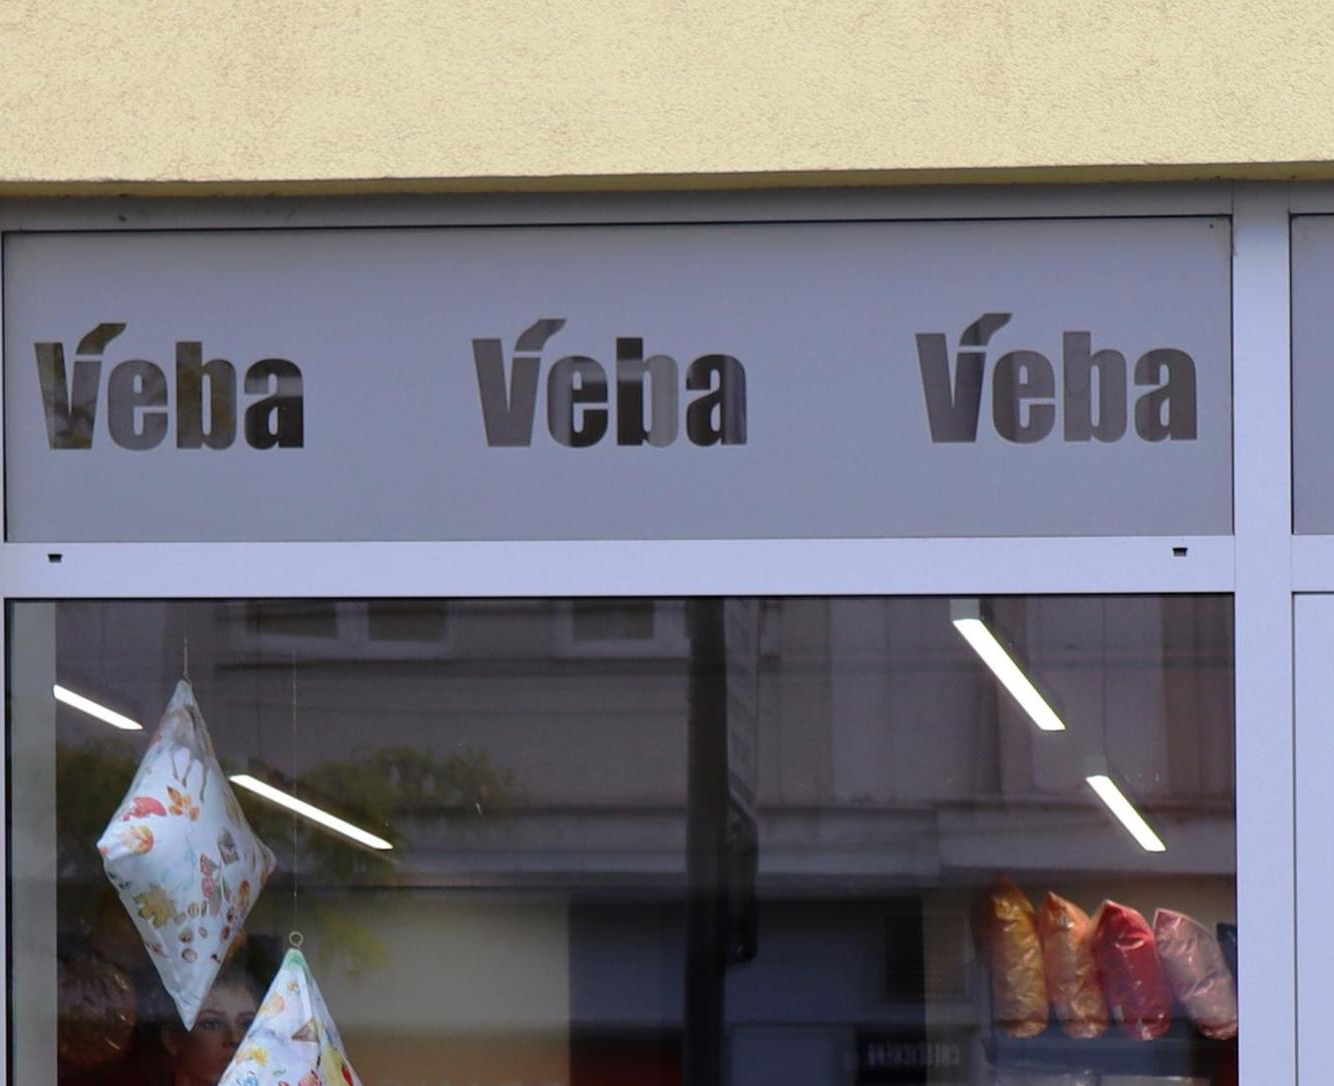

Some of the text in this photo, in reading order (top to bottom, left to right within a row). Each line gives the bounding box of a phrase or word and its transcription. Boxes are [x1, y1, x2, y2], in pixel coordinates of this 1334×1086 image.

[34, 323, 304, 450] Veba
[471, 318, 748, 448] Veba
[914, 312, 1198, 443] Veba
